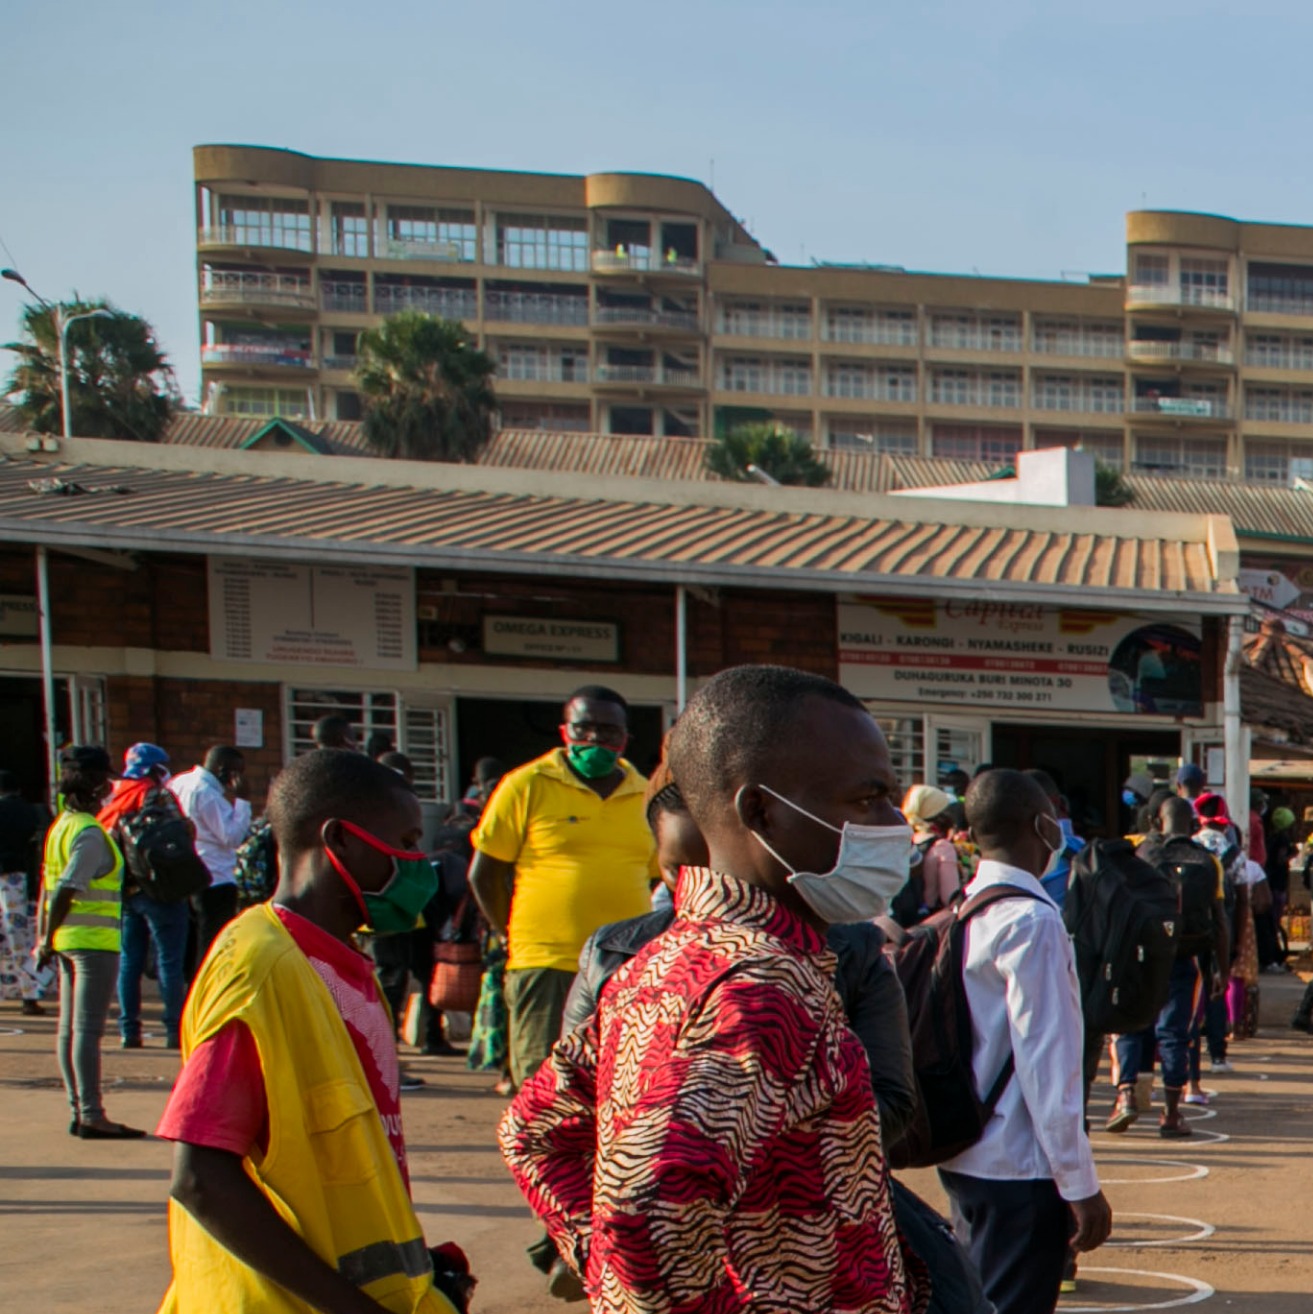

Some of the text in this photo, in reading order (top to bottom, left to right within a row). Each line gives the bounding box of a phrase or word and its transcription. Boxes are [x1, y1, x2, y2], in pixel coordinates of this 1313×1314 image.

[493, 621, 611, 640] OMEGA EXPRESS
[841, 633, 1109, 656] KIGALI KARONGI NYAMASHEKE RUSIZI
[979, 673, 1006, 685] BURI
[1010, 674, 1053, 688] MINOTA
[1057, 677, 1073, 688] 30
